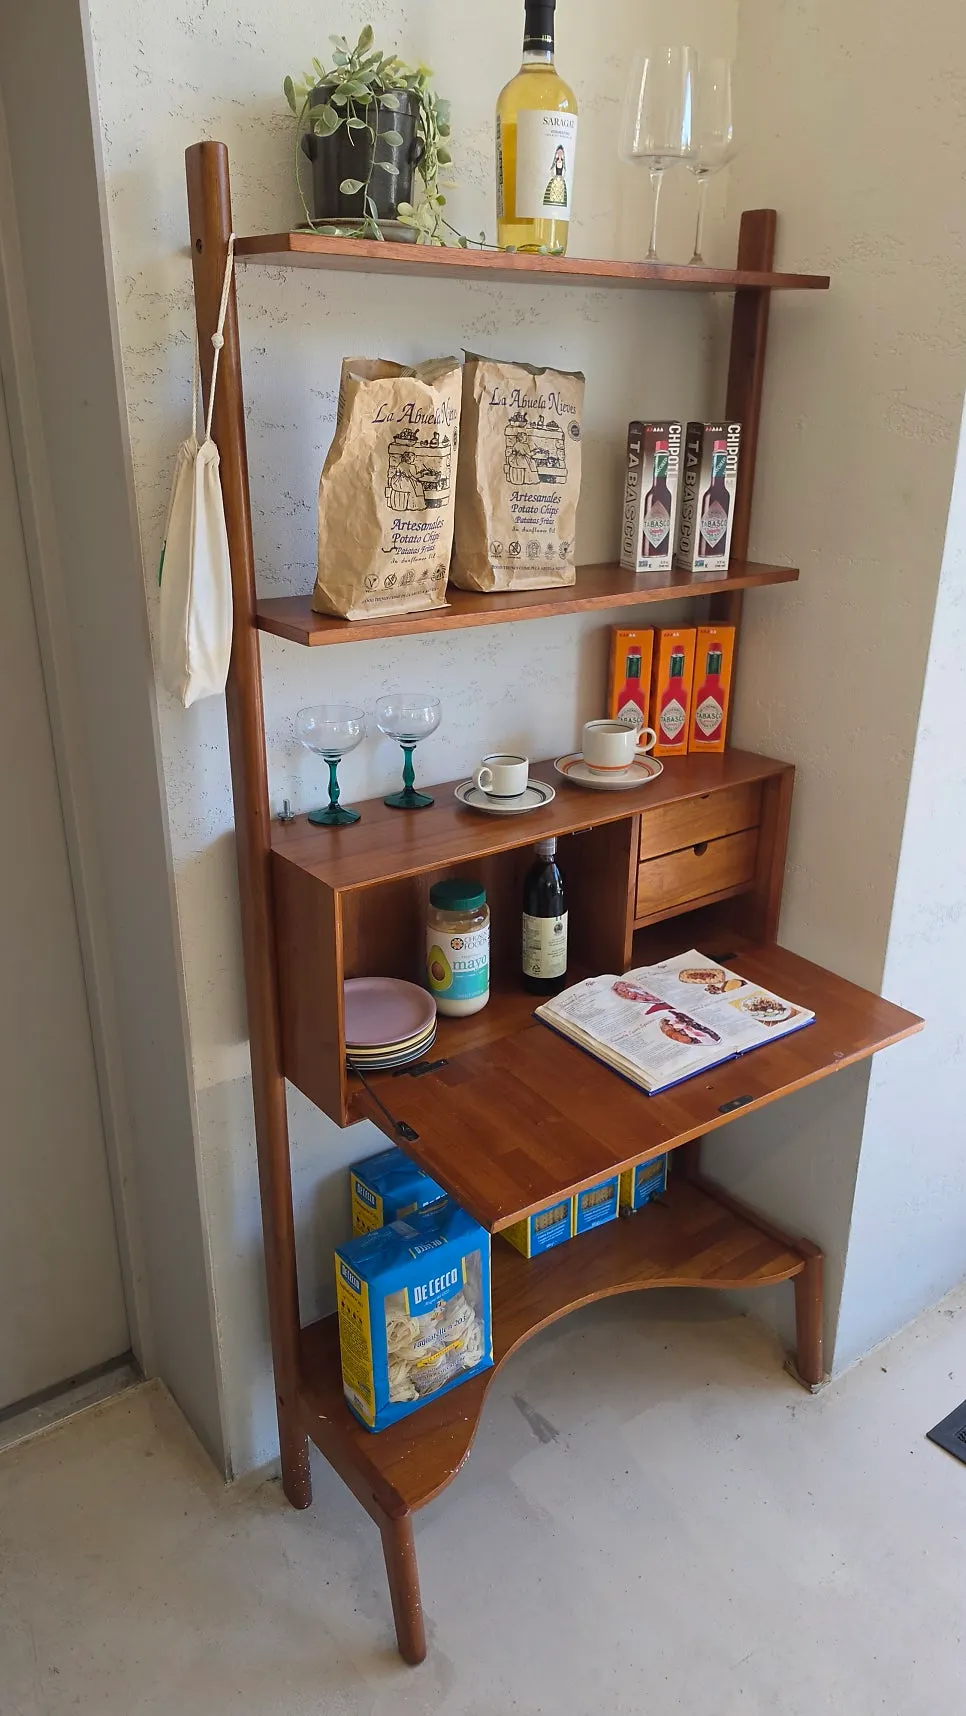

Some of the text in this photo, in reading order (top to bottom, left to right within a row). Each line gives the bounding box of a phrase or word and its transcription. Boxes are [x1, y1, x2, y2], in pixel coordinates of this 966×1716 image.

[489, 387, 577, 416] La Abuela Nieves
[371, 403, 394, 423] La
[397, 402, 441, 425] Abuela
[510, 491, 562, 504] Artesanales
[511, 504, 559, 518] Potato Chips
[391, 516, 445, 531] Artesanales
[391, 533, 422, 544] Potato
[453, 954, 488, 971] mayo
[414, 1285, 428, 1305] DE
[429, 1268, 458, 1297] CECCO
